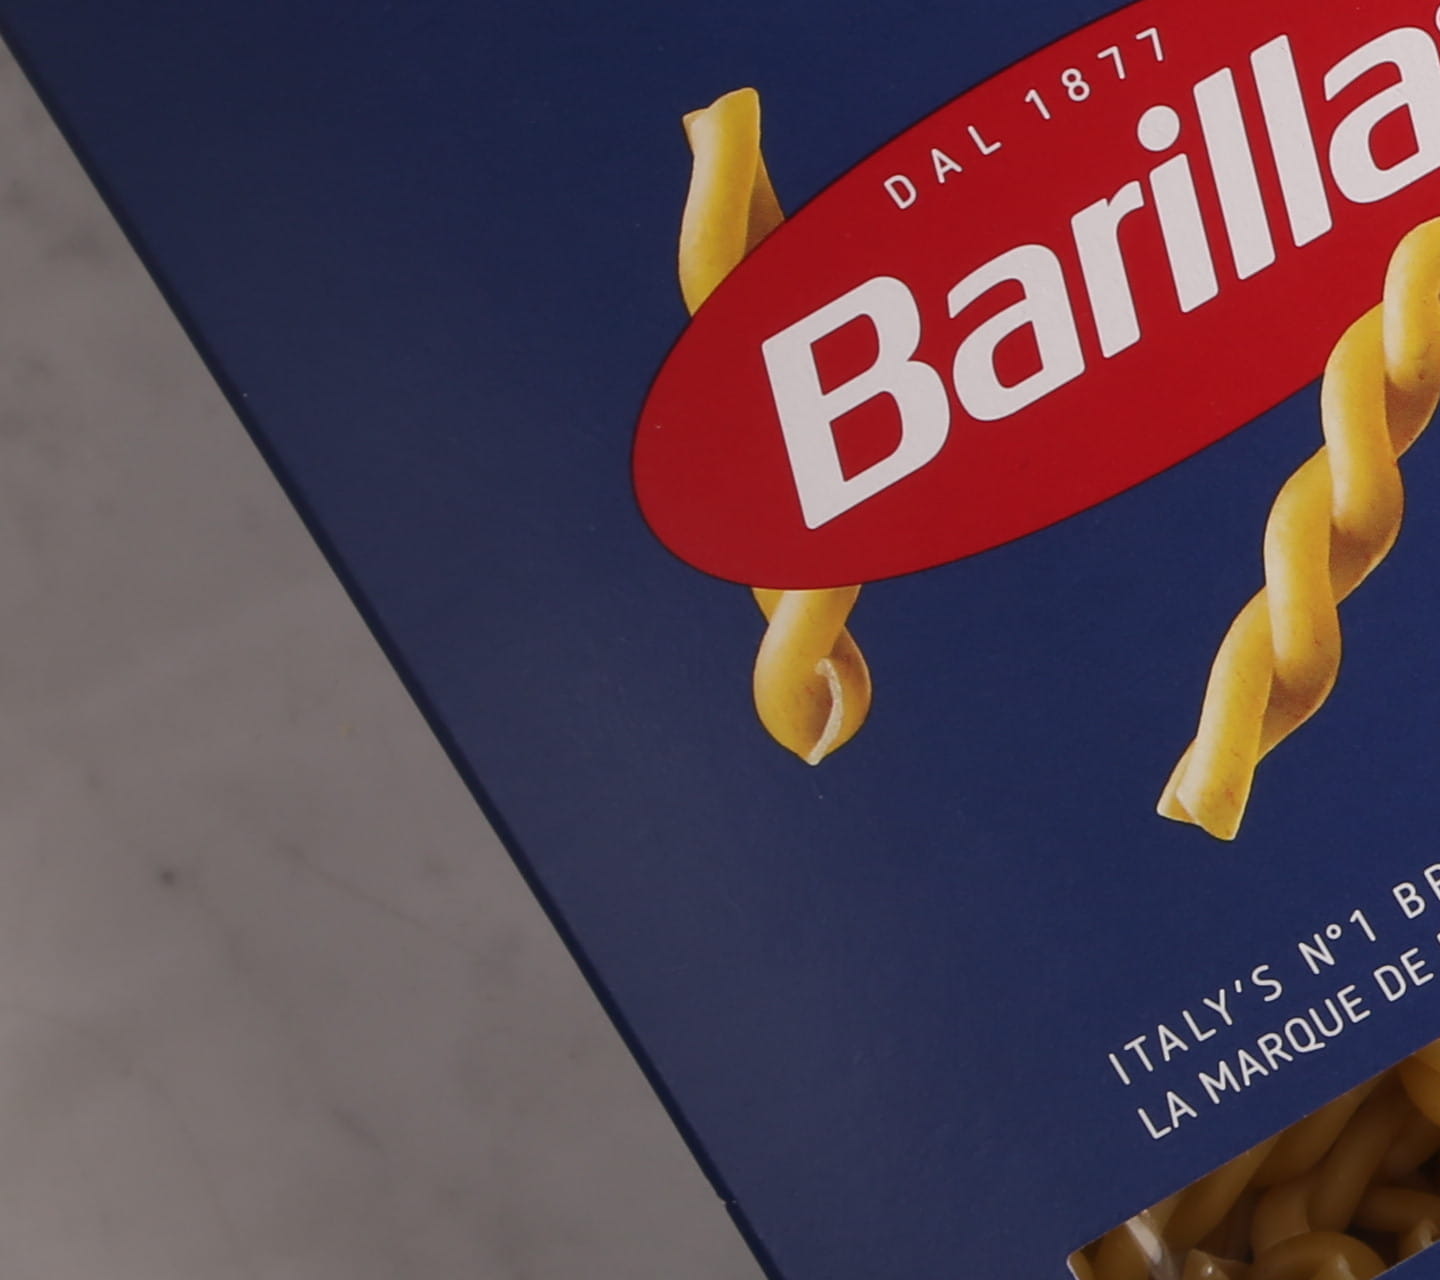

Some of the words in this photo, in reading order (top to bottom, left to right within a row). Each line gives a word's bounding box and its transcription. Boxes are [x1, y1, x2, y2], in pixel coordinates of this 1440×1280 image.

[884, 126, 1001, 209] DAL
[1025, 28, 1163, 119] 1877
[1109, 965, 1282, 1084] ITALY'S
[1138, 1092, 1197, 1139] LA
[1199, 985, 1370, 1104] MARQUE
[1374, 948, 1433, 1001] DE
